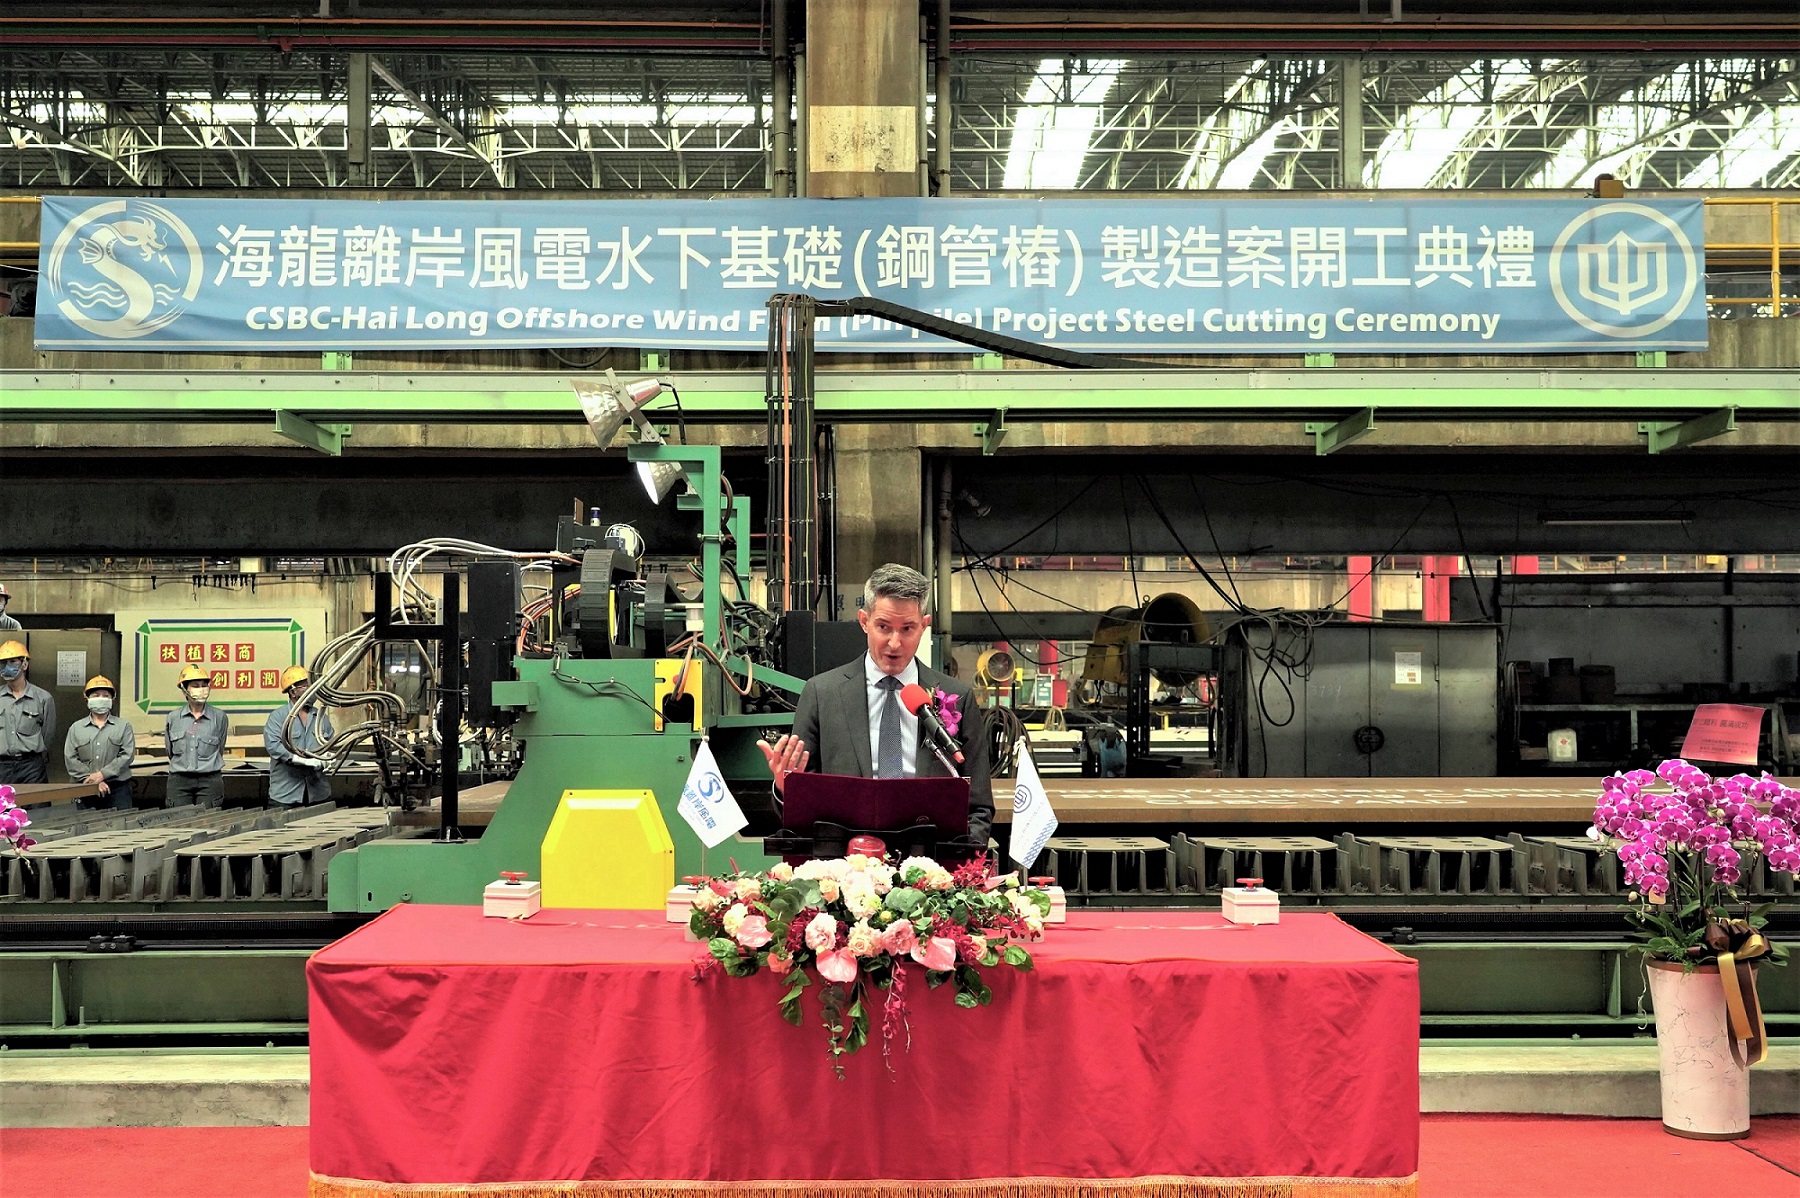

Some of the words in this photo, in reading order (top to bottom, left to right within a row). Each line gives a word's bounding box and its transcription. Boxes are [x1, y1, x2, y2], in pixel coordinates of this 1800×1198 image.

[213, 223, 1537, 297] 海龍離岸風電水下基礎(鋼管樁)製造案開工典禮
[245, 305, 398, 330] CSBC-Hai
[405, 306, 488, 337] Long
[496, 307, 645, 329] Offshore
[653, 309, 740, 332] Wind
[748, 309, 831, 332] Fm
[992, 307, 1108, 339] Project
[1115, 308, 1195, 332] Steel
[1202, 308, 1327, 339] Cutting
[1335, 308, 1501, 339] Ceremony
